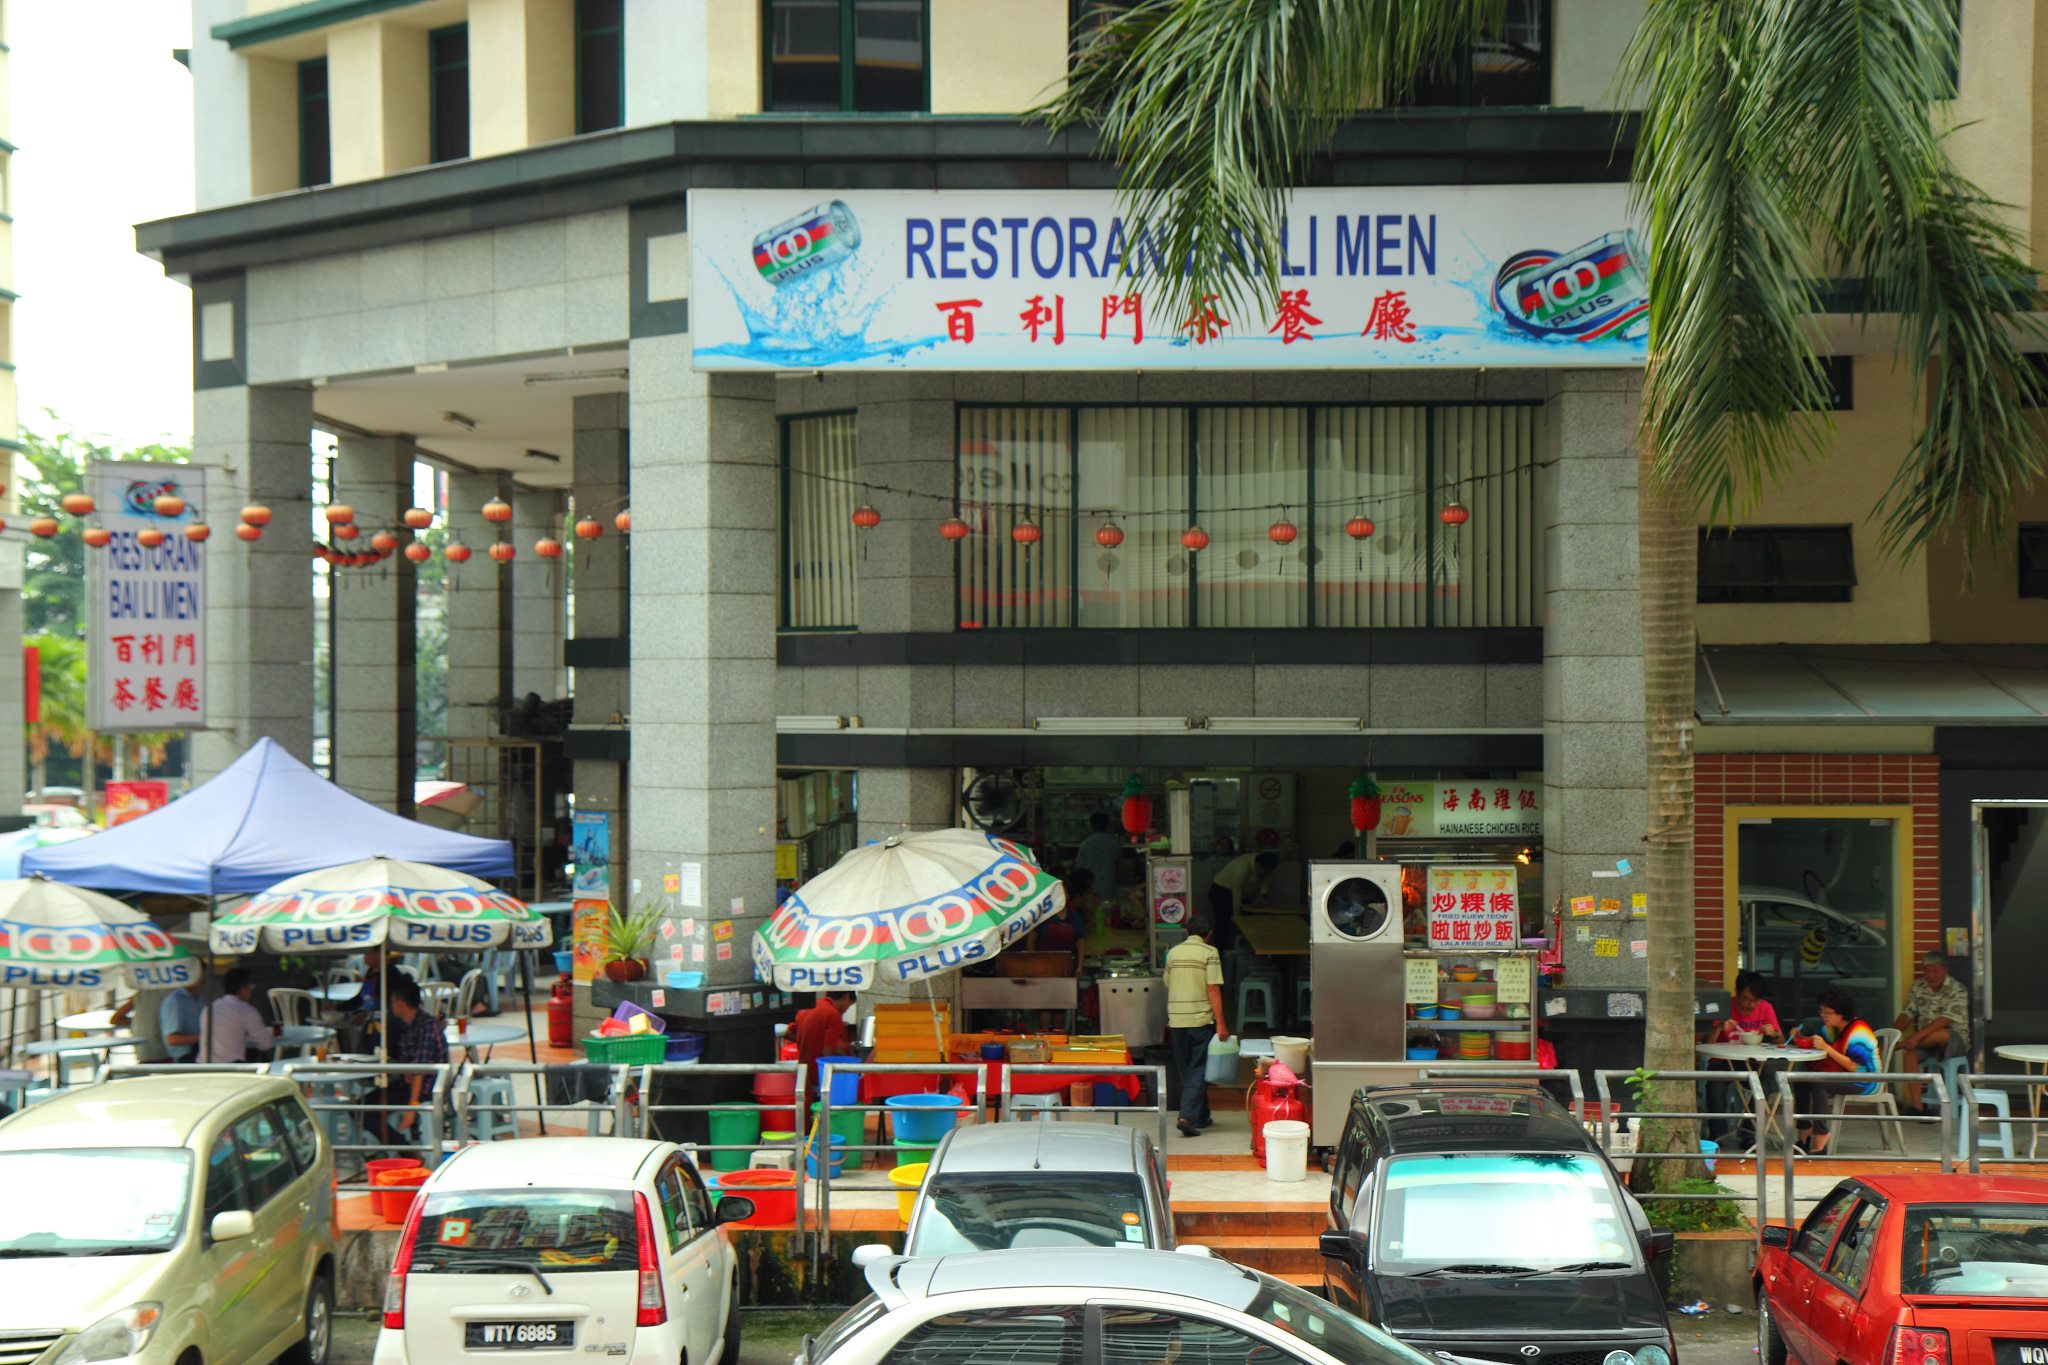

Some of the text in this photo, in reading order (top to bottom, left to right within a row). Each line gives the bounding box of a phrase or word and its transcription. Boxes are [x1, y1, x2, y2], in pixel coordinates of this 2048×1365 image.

[906, 216, 1166, 279] RESTORAN
[1281, 215, 1317, 276] LI
[1336, 214, 1437, 277] MEN
[777, 255, 824, 281] PLUS
[1551, 294, 1614, 328] PLUS
[162, 580, 198, 620] MEN
[111, 632, 196, 666] 百利門
[1376, 793, 1424, 804] EASONS
[1440, 822, 1540, 834] HAINANESE CHICKEN RICE
[1432, 892, 1514, 913] 炒粿條
[1007, 894, 1054, 941] PLUS
[284, 923, 372, 947] PLUS
[407, 922, 492, 943] PLUS
[1431, 920, 1514, 941] 啦啦炒飯
[897, 939, 986, 980] PLUS
[4, 966, 103, 987] PLUS
[135, 964, 189, 985] PLUS
[789, 965, 863, 987] PLUS
[441, 1220, 468, 1242] P
[484, 1324, 557, 1343] WTY 6885
